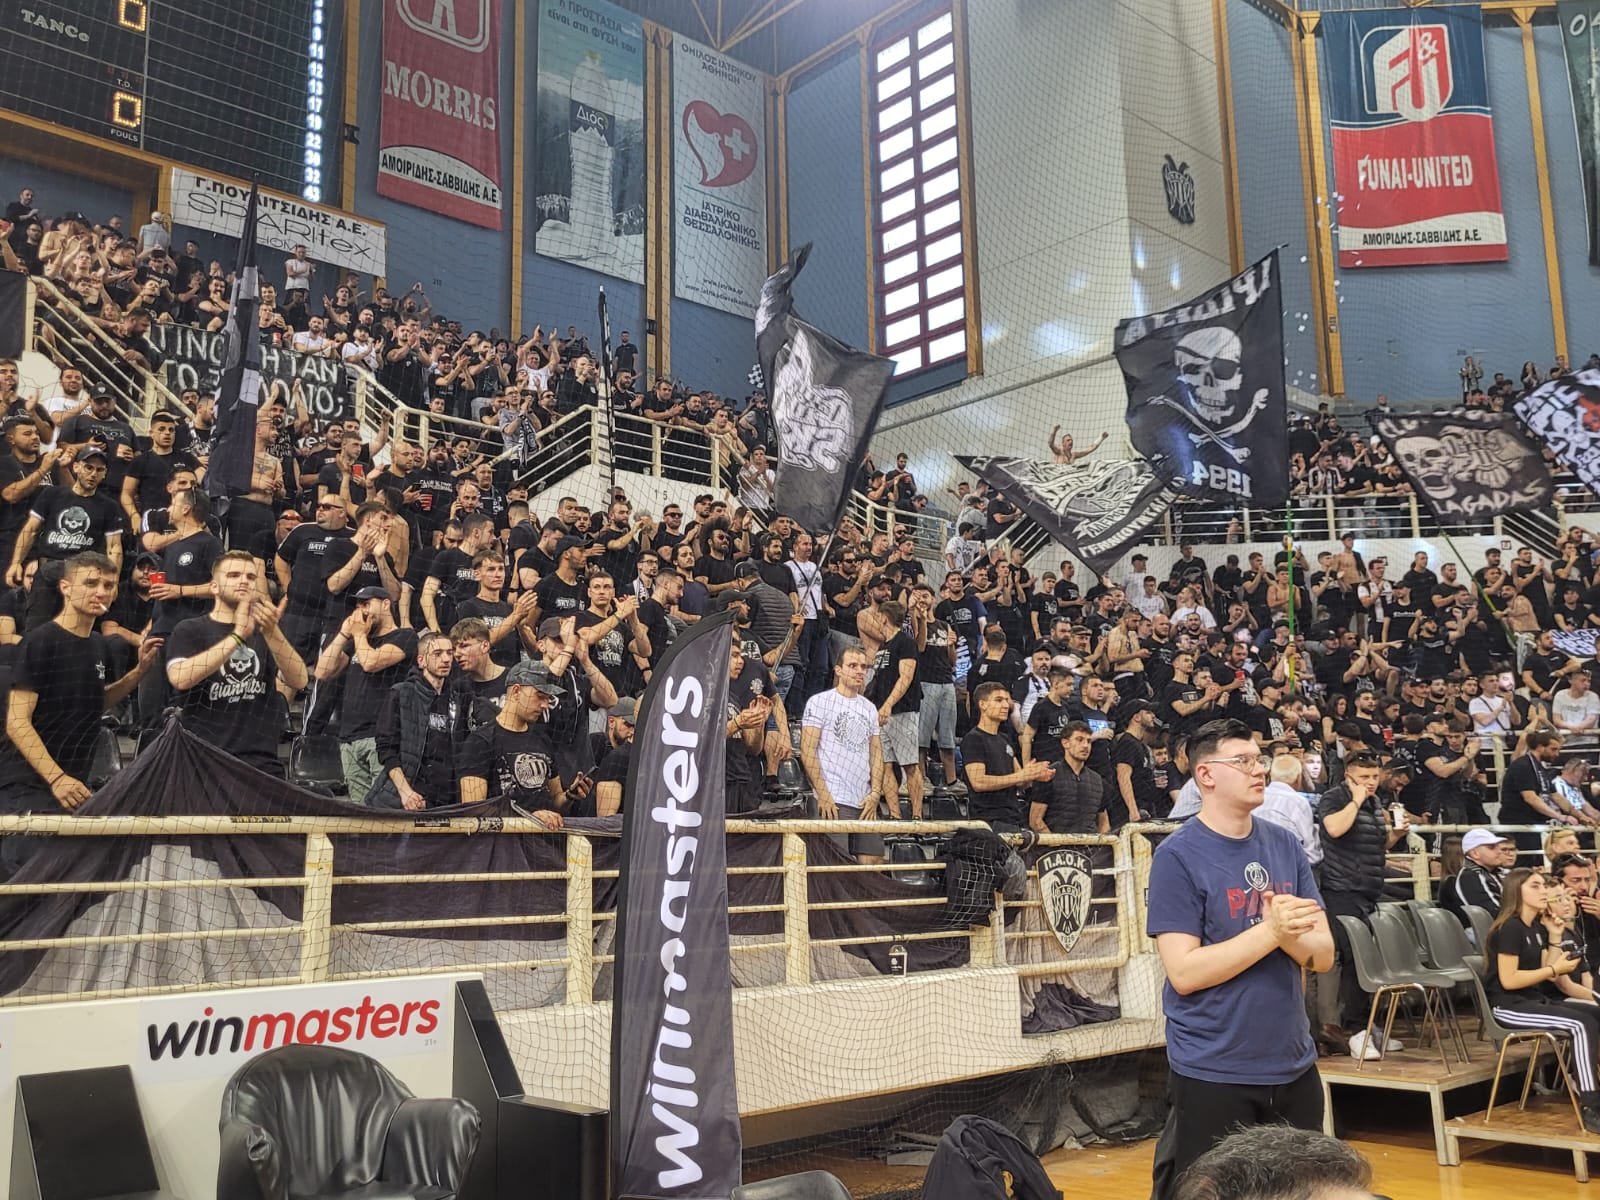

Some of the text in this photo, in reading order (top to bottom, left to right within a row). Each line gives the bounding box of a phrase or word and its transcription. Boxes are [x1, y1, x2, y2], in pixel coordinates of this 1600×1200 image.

[384, 60, 496, 131] MORRIS
[110, 128, 139, 142] FOULS
[1357, 155, 1473, 190] FUNAI-UNITED
[1432, 477, 1547, 517] LAGADAS
[209, 677, 267, 701] Giannitsa
[147, 995, 441, 1061] winmasters
